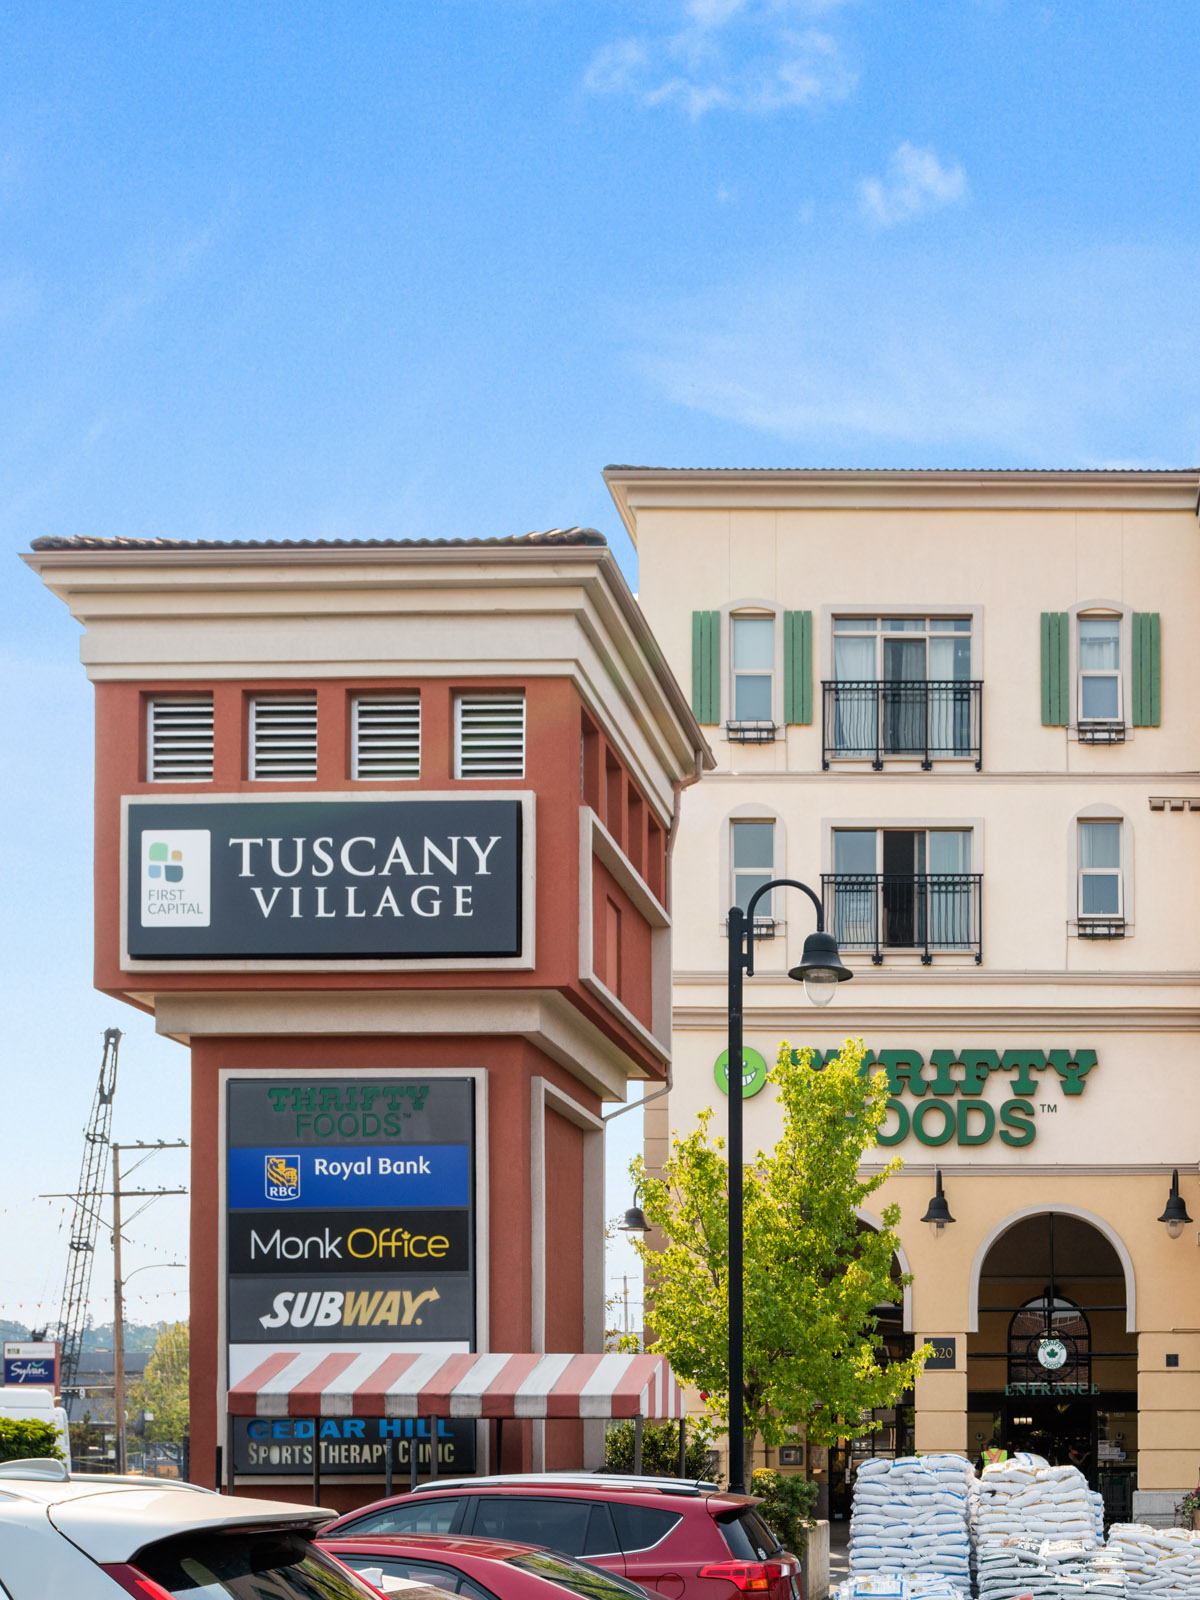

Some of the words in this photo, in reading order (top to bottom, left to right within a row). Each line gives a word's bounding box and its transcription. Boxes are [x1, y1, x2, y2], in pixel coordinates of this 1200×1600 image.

[228, 836, 502, 877] TUSCANY
[148, 889, 184, 901] FIRST
[250, 885, 474, 918] VILLAGE
[148, 902, 204, 915] CAPITAL
[777, 1049, 1098, 1096] RIFTY
[268, 1086, 430, 1112] THRIFTY
[296, 1112, 402, 1137] FOODS
[836, 1099, 1036, 1147] OODS
[314, 1156, 372, 1180] Royal
[378, 1155, 431, 1174] Bank
[269, 1186, 297, 1197] RBC
[250, 1227, 343, 1259] Monk
[347, 1228, 449, 1258] Office
[1041, 1340, 1064, 1350] THRIFTY
[10, 1361, 48, 1383] Sylvan
[1043, 1360, 1062, 1369] FOODS
[1005, 1383, 1100, 1396] ENTRANCE
[247, 1418, 366, 1439] CEDAR
[379, 1418, 454, 1438] HILL
[248, 1442, 313, 1465] SPORTS
[398, 1440, 455, 1463] CINIC
